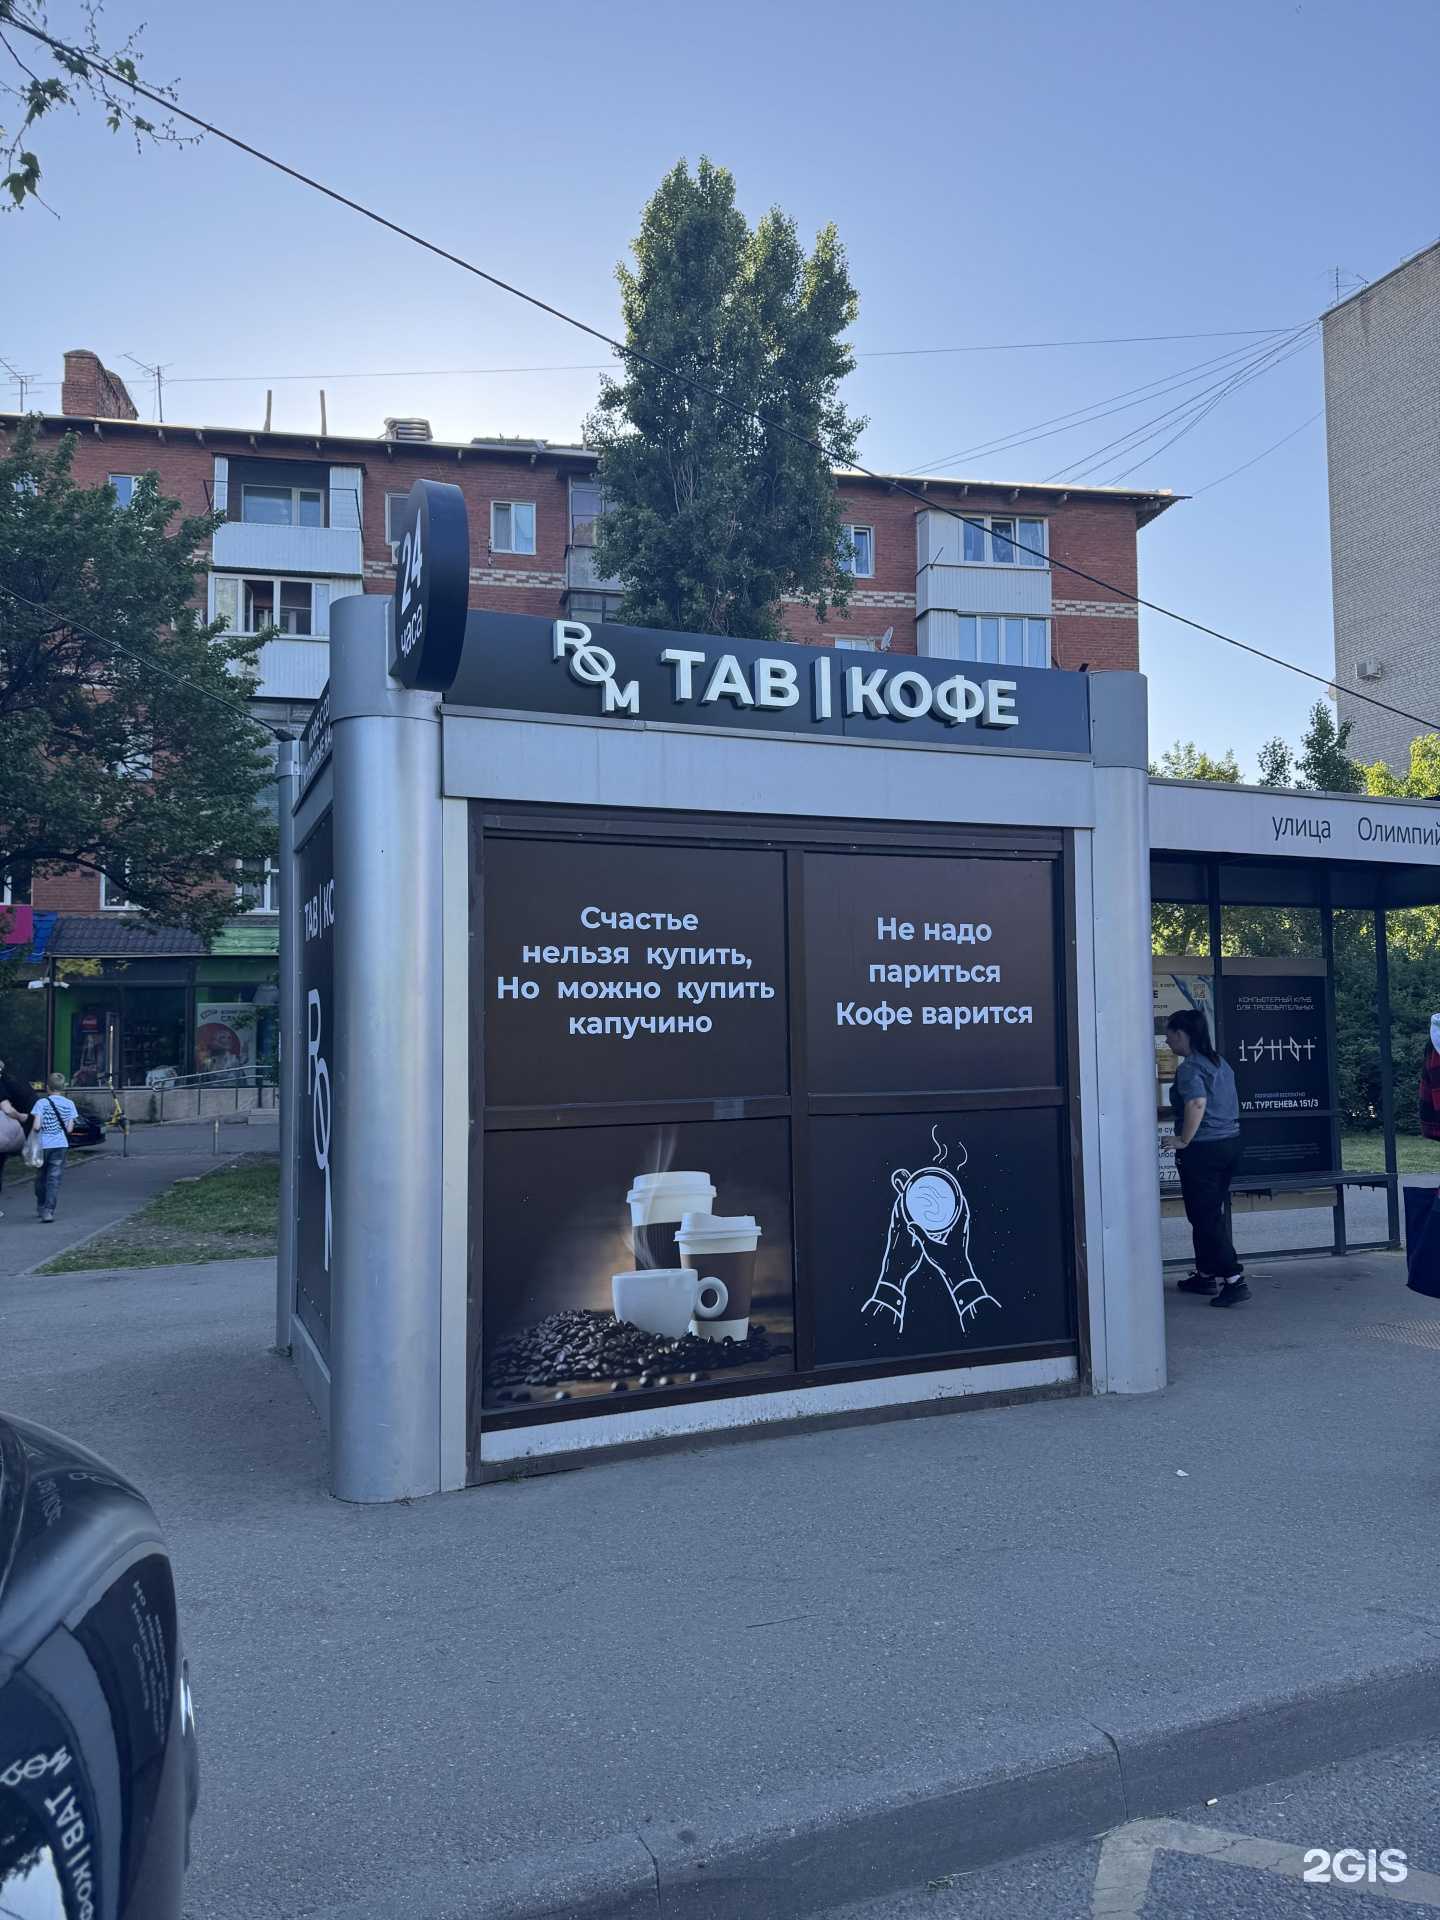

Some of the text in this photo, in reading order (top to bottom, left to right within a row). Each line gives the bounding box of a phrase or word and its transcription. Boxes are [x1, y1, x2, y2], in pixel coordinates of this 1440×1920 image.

[401, 508, 424, 615] 24
[400, 603, 424, 658] часа
[845, 666, 1020, 727] КОФЕ
[1273, 816, 1331, 843] улица
[581, 906, 699, 931] Счастье
[877, 916, 993, 945] Не надо
[522, 944, 753, 972] нельзя купить,
[869, 964, 1001, 987] париться
[497, 976, 775, 1005] Но можно купить
[569, 1015, 713, 1040] капучино
[836, 1001, 1033, 1030] Кофе варится
[1255, 1099, 1298, 1109] ТУРГЕНЕВА
